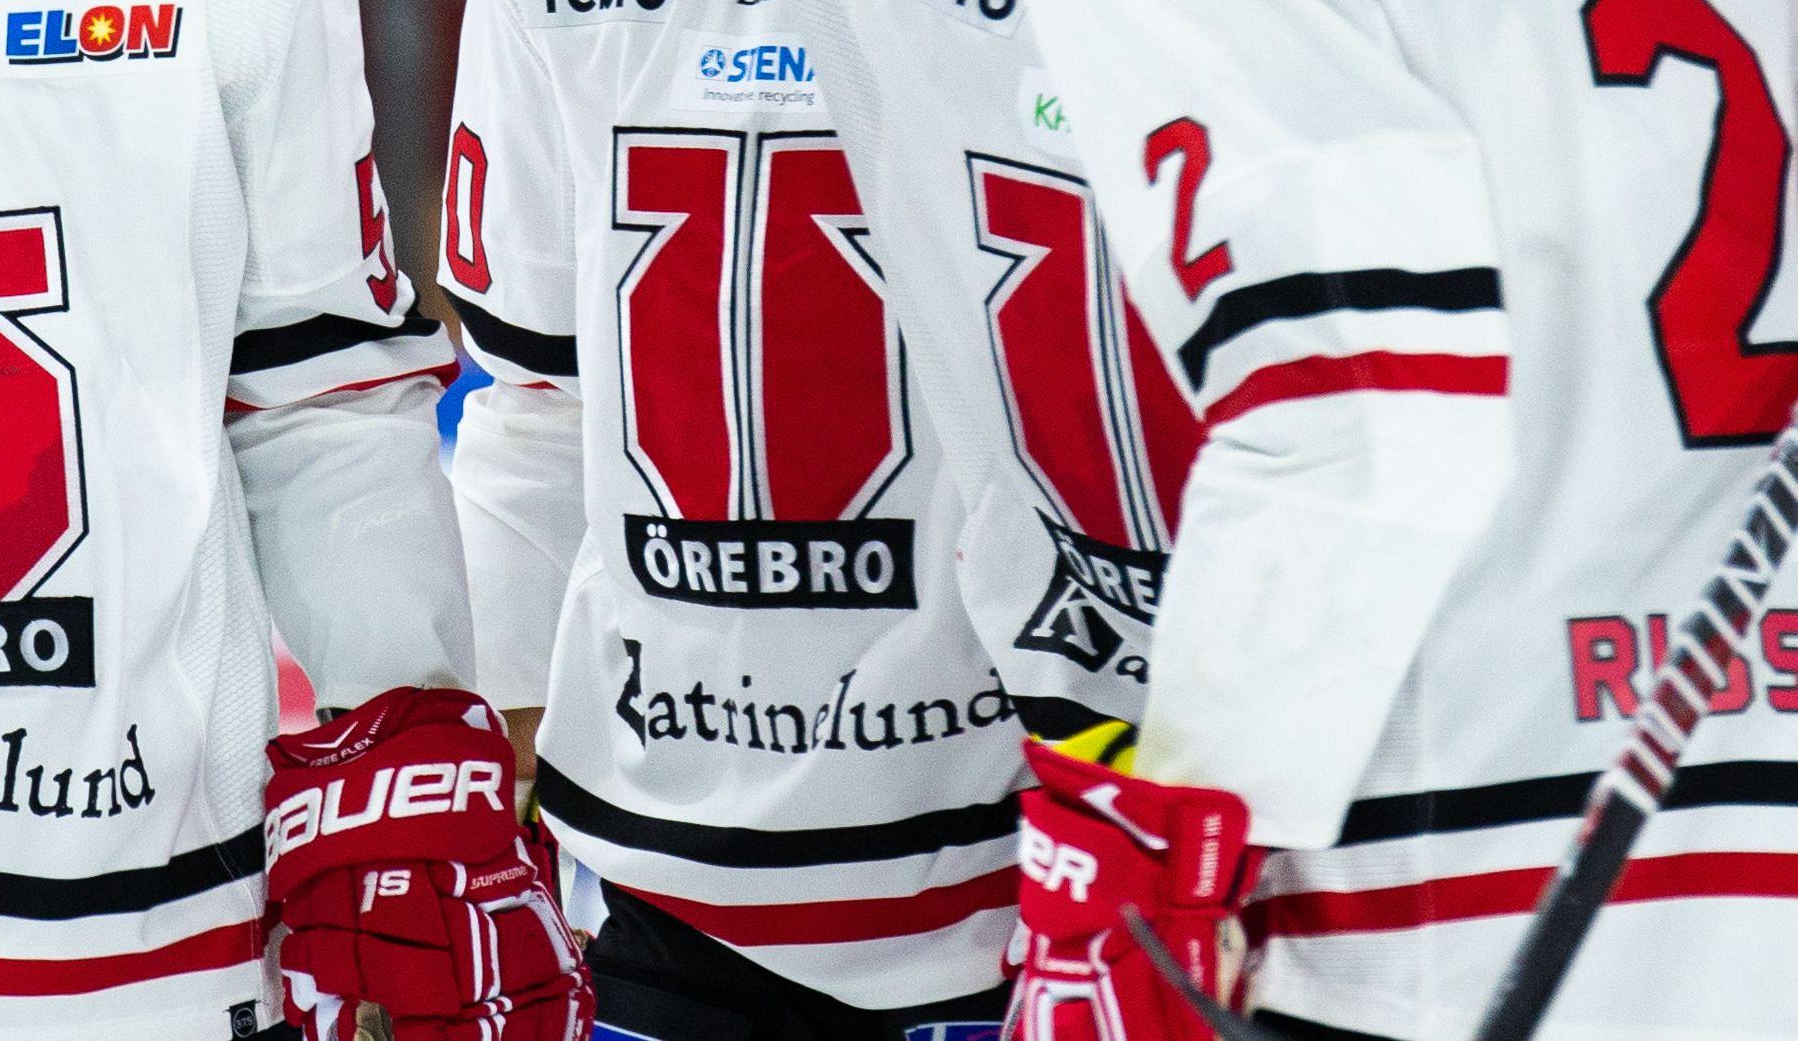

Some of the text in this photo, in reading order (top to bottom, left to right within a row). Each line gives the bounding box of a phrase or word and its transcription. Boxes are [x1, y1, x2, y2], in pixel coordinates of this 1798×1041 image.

[5, 3, 183, 65] ELON
[1143, 116, 1234, 302] 2
[643, 524, 896, 594] ÖREBRO
[1055, 529, 1159, 615] ÖRE
[264, 759, 505, 874] BAUER
